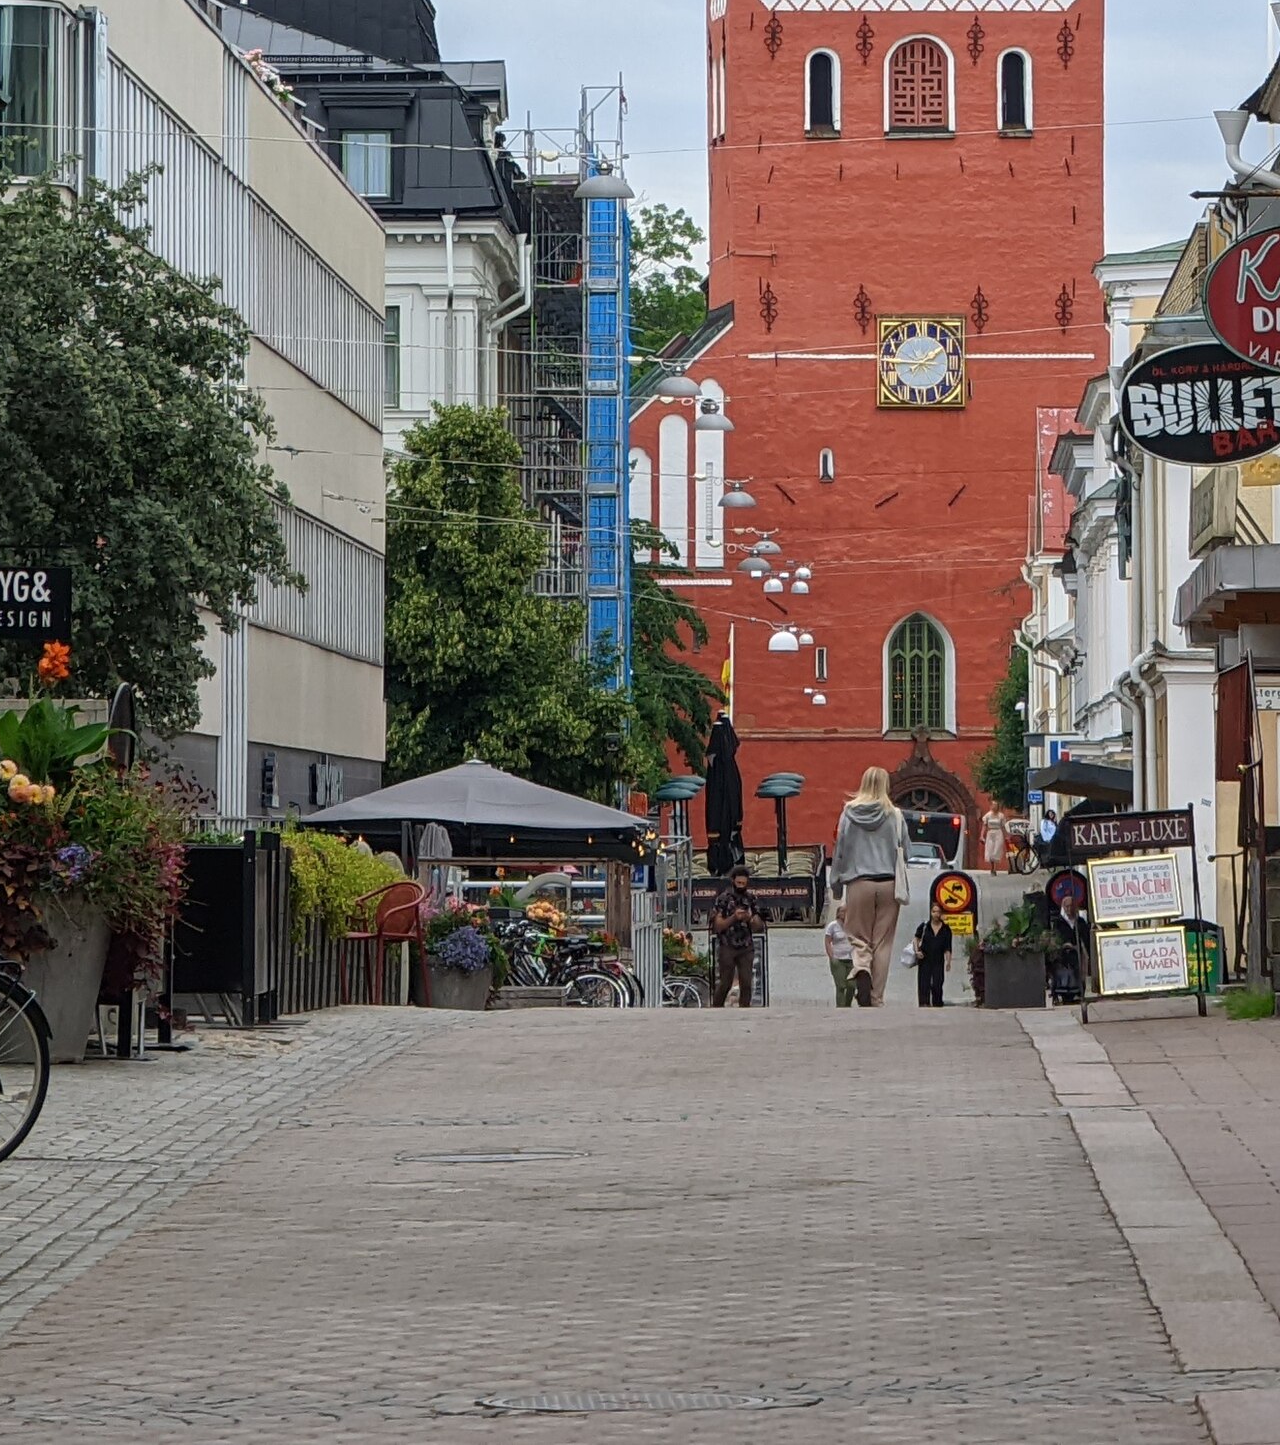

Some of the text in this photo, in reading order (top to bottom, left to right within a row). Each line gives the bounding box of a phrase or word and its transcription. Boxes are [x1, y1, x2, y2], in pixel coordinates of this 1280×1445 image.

[1212, 418, 1280, 456] BAR
[1099, 878, 1172, 898] LUNCH
[1132, 947, 1178, 959] GLADA
[1133, 958, 1180, 971] TIMMEN
